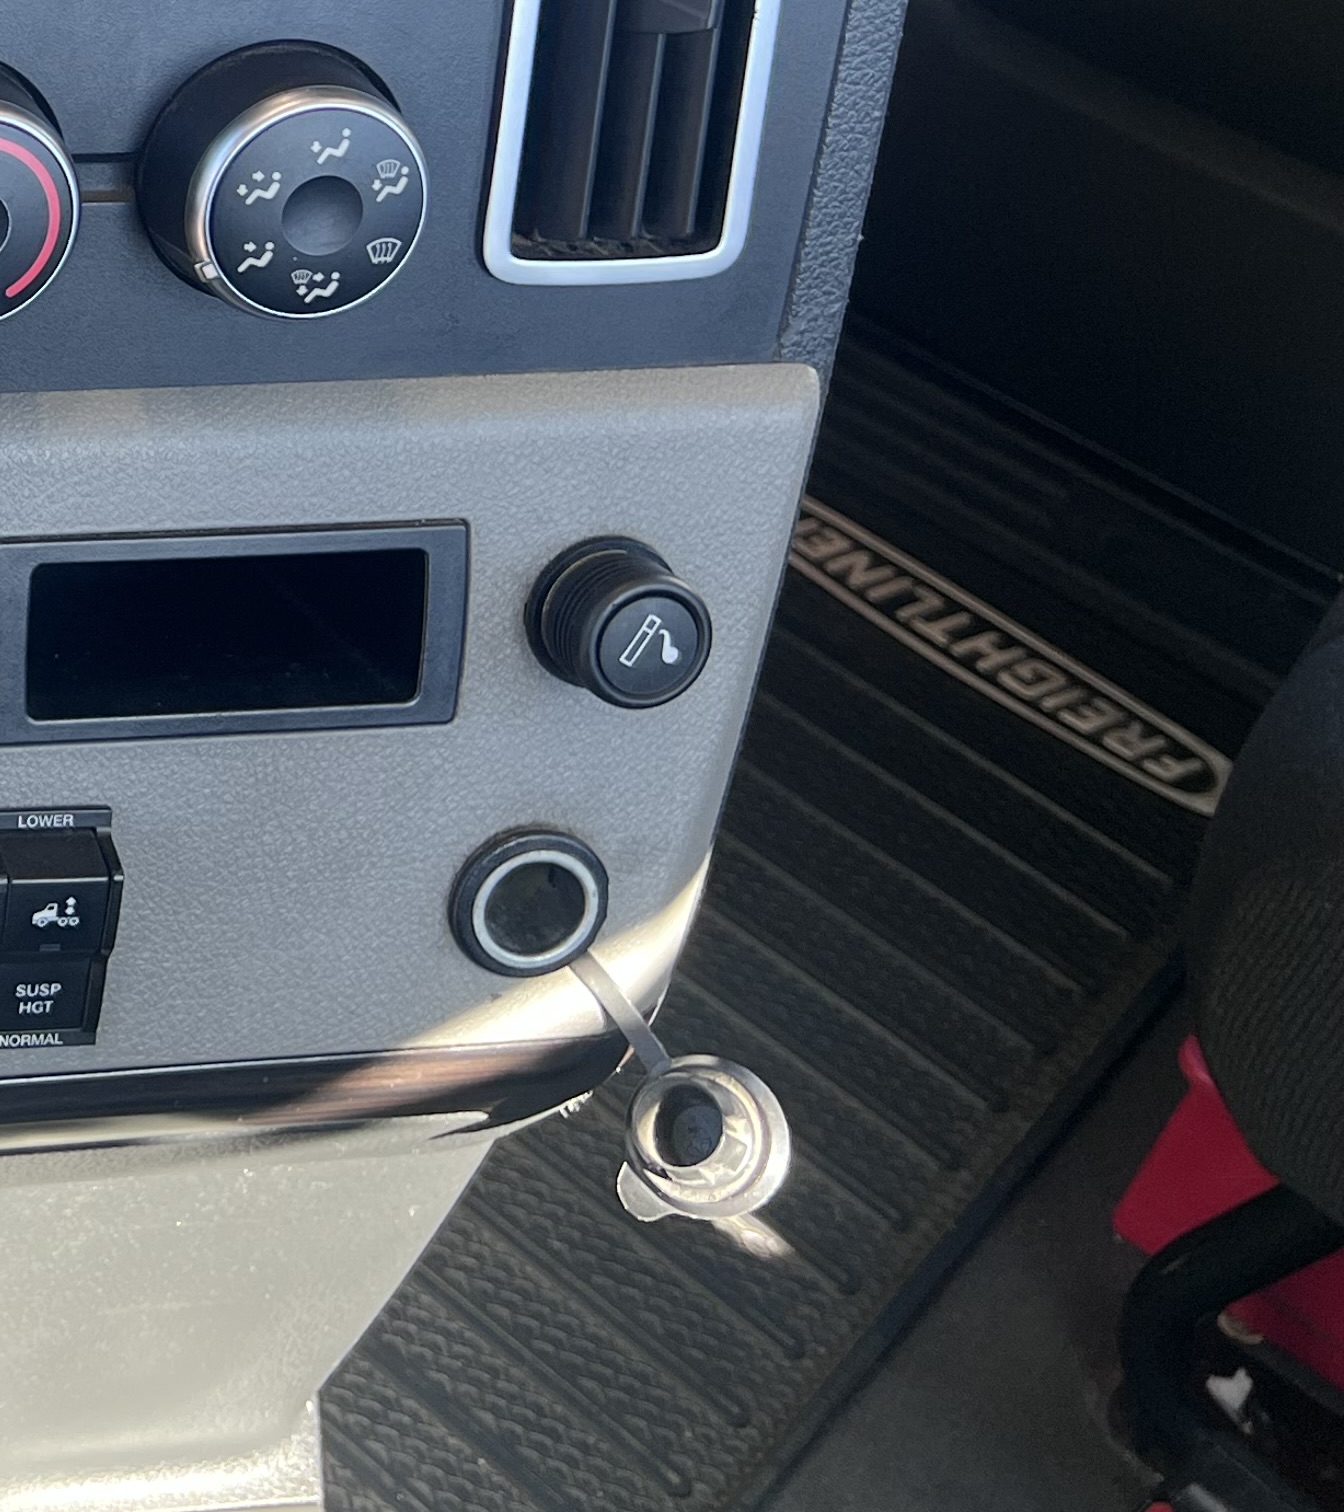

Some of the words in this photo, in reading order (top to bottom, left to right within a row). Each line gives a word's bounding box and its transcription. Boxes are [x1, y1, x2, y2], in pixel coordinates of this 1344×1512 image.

[792, 516, 1205, 780] FREIGHTLINE
[18, 814, 74, 829] LOWER
[16, 983, 62, 998] SUSP
[18, 1000, 54, 1015] HGT
